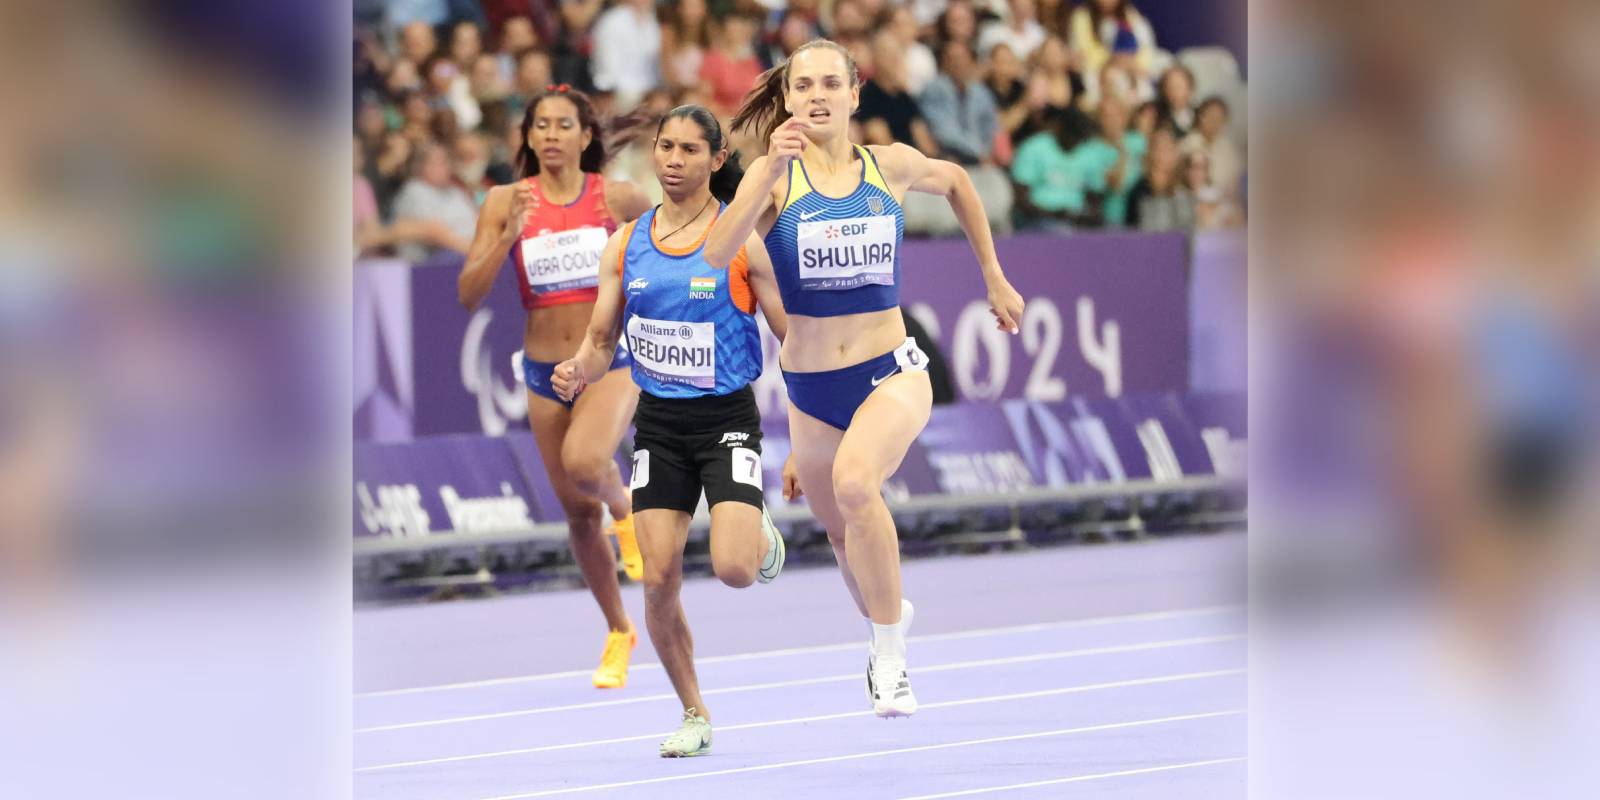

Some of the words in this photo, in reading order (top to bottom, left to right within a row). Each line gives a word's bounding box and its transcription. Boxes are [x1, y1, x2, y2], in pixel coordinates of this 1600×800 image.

[802, 242, 893, 269] SHULIAR
[689, 291, 715, 300] INDIA
[640, 322, 677, 337] Allianz
[630, 335, 711, 367] JEEVANJI
[718, 431, 750, 444] JSW
[745, 456, 757, 478] 7
